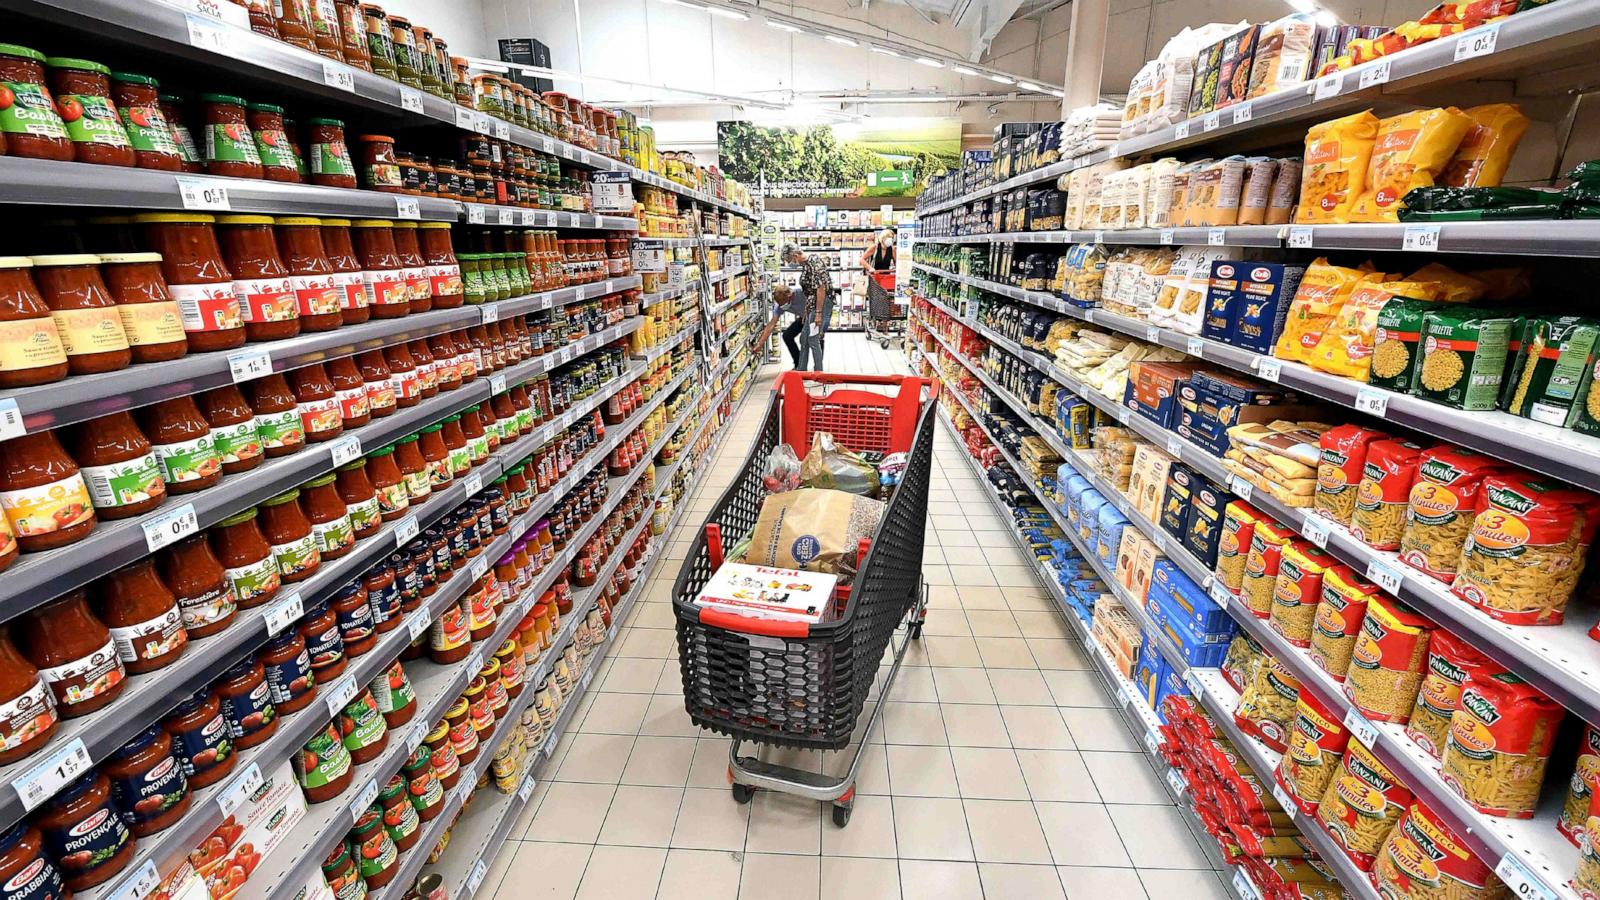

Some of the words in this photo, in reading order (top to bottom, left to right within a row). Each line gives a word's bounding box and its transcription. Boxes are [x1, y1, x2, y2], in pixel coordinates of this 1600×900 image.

[1421, 463, 1455, 482] PANZANI
[1424, 487, 1436, 499] 3
[1486, 515, 1506, 530] 3
[755, 566, 799, 577] Tefal
[1429, 658, 1466, 682] PANZANI
[1433, 682, 1447, 693] 3
[1315, 717, 1331, 729] ECO
[1462, 719, 1477, 732] 3
[1290, 744, 1314, 761] nutes
[1352, 745, 1377, 770] FORMAT
[1350, 759, 1387, 790] PANZANI
[1353, 785, 1371, 798] 3
[65, 813, 119, 852] PROVENÇALE
[1404, 821, 1439, 859] PANZANI
[1435, 833, 1456, 851] ECO
[7, 863, 54, 900] RRABBIATA
